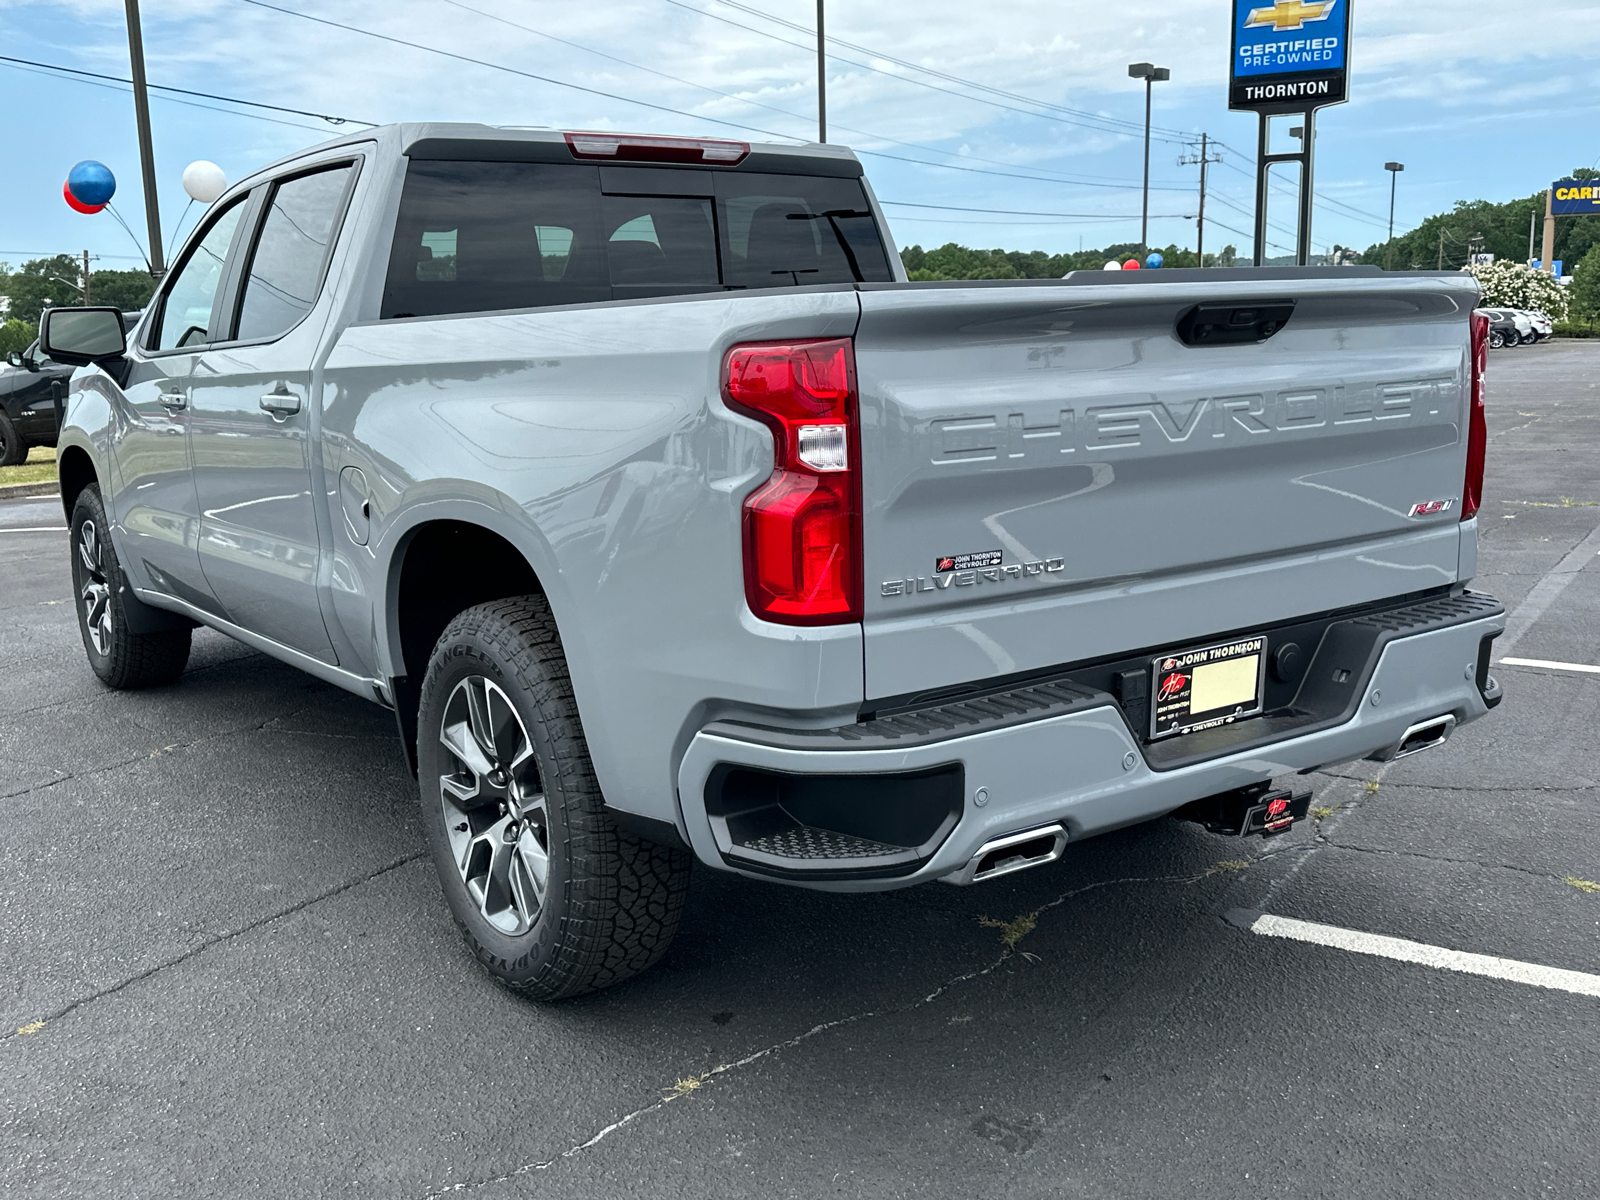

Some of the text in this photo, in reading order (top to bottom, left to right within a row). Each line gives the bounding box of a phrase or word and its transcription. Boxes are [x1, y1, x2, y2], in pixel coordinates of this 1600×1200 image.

[1239, 37, 1338, 57] CERTIFIED
[1243, 49, 1332, 67] PRE-OWNED
[1245, 80, 1329, 99] THORNTON
[929, 376, 1454, 465] CHEVROLET
[1407, 497, 1459, 517] RST
[954, 559, 990, 570] CHEVROLET
[955, 551, 1001, 563] JOHN THORNTON
[881, 556, 1065, 597] SILVERADO
[1181, 651, 1208, 666] JOHN
[1209, 639, 1261, 659] THORNTON
[1192, 719, 1224, 732] CHEVROLET
